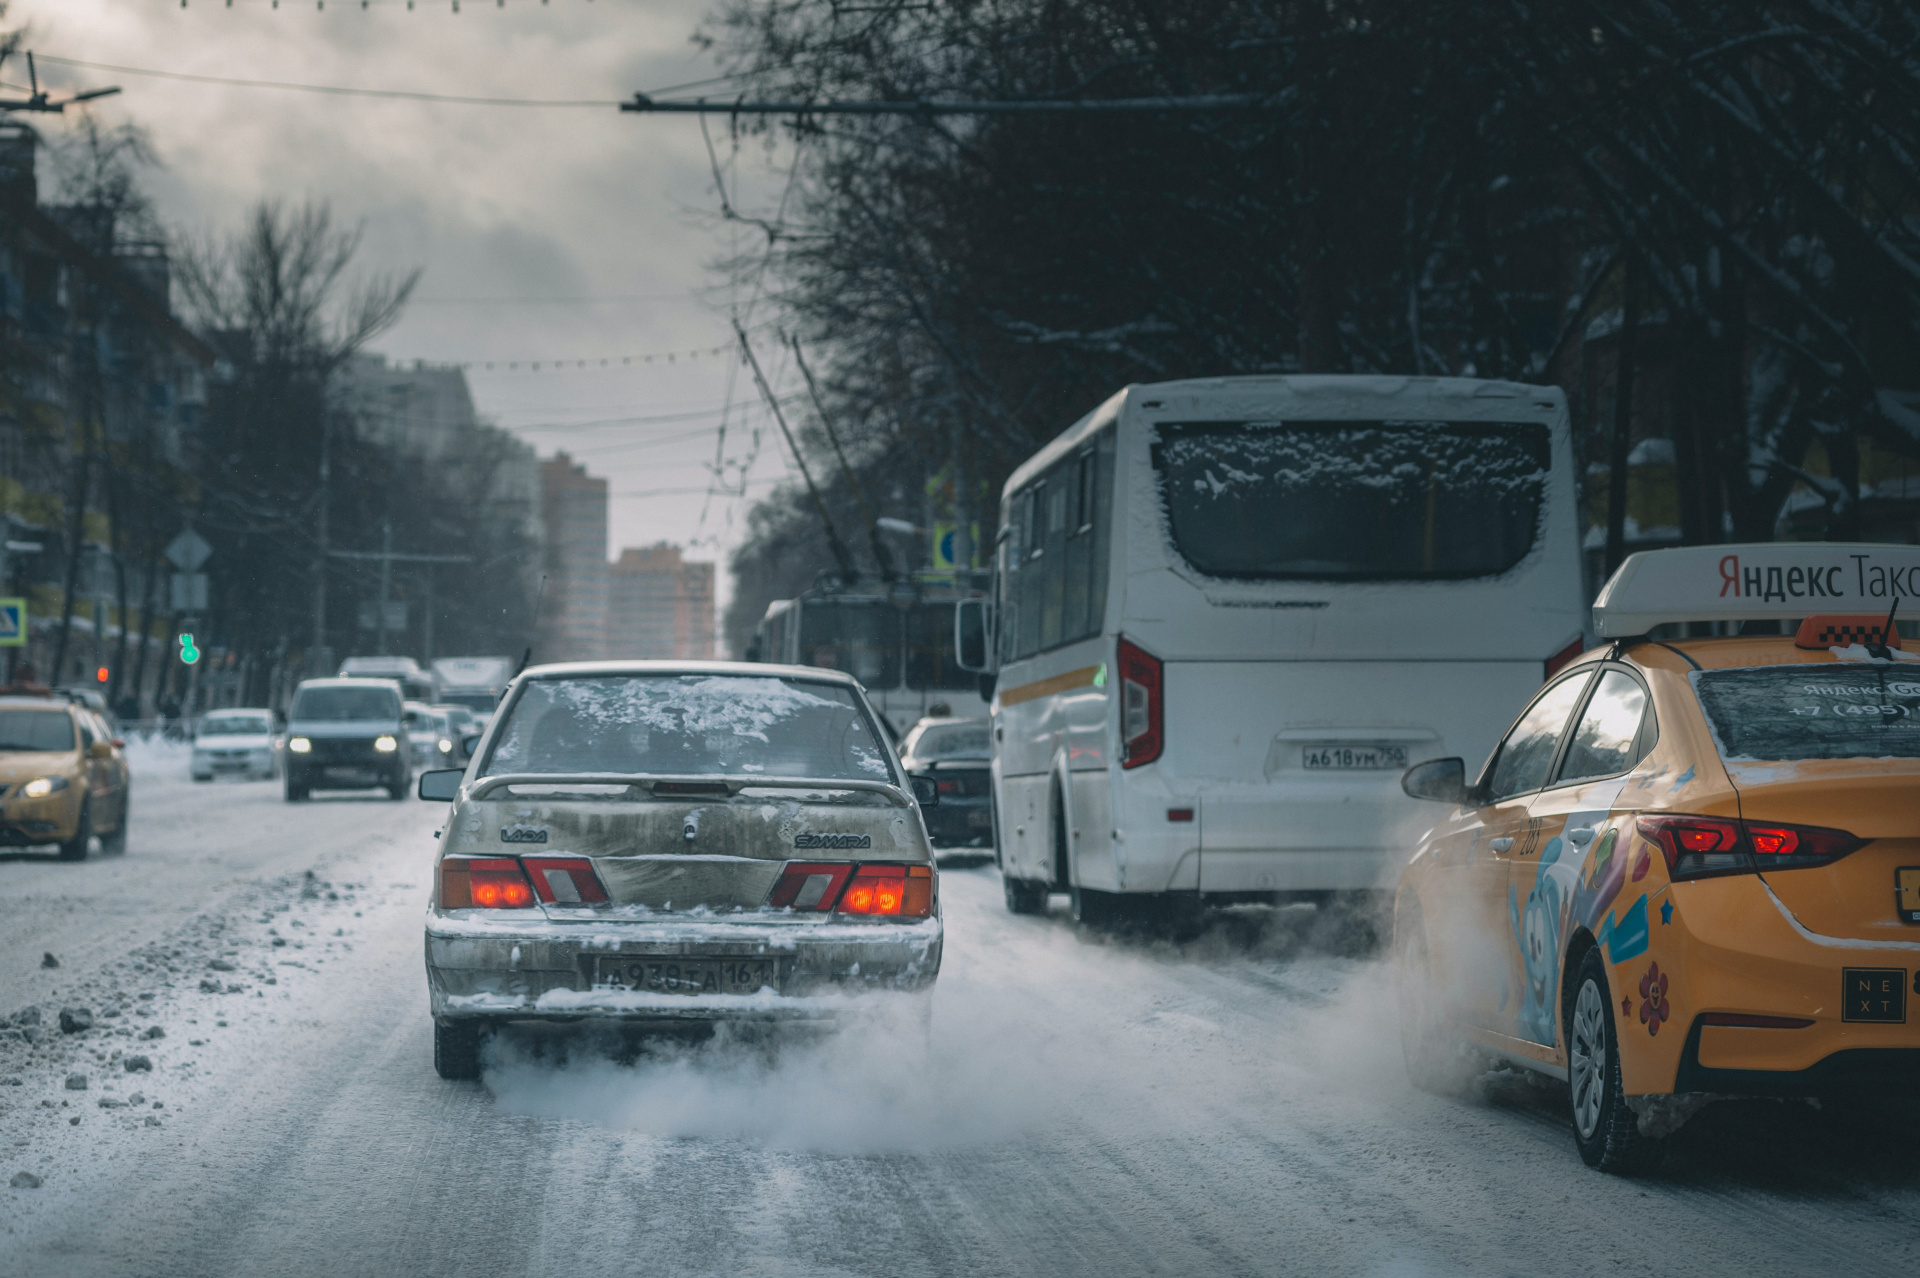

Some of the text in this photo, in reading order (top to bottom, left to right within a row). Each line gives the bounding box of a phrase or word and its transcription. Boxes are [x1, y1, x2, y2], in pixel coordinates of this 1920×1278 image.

[1718, 554, 1844, 603] Яндекс
[1804, 684, 1887, 696] Яндекс
[1788, 706, 1820, 716] +7
[1833, 705, 1910, 717] (495)
[501, 829, 547, 843] LADA
[795, 834, 871, 849] SAMARA
